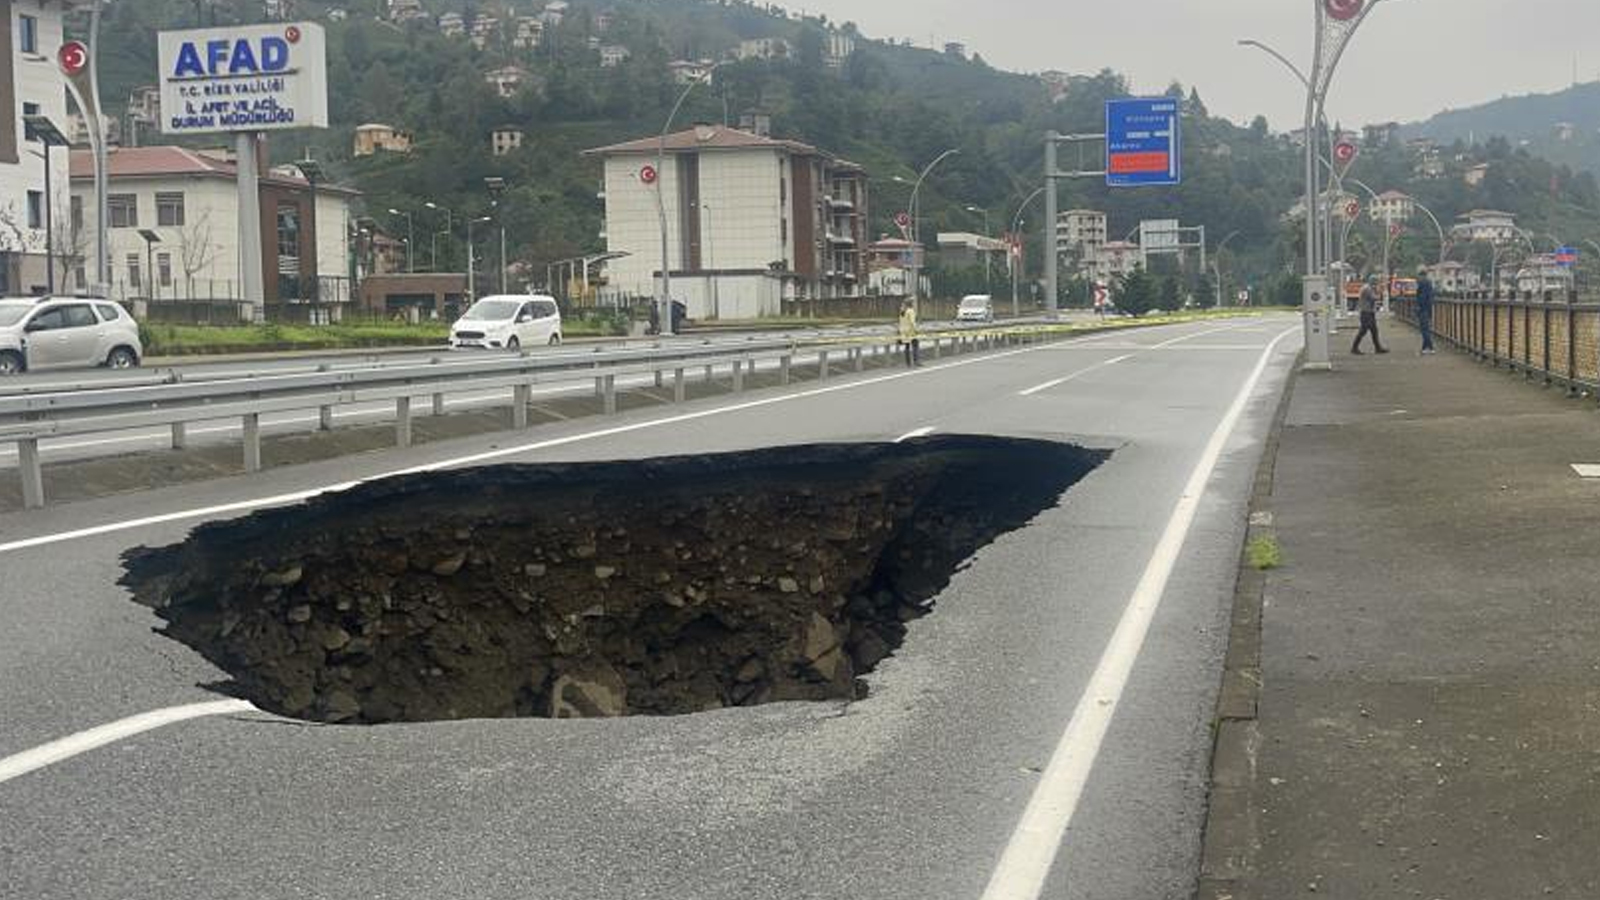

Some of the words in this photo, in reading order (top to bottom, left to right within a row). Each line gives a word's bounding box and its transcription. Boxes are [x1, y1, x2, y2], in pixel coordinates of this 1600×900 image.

[174, 37, 289, 76] AFAD
[180, 87, 200, 97] T.C.
[234, 79, 284, 95] VALİLİĞİ
[201, 100, 229, 113] AFET
[233, 99, 248, 112] VE
[171, 115, 214, 128] DURUM
[220, 108, 294, 126] MÜDÜRLÜĞÜ
